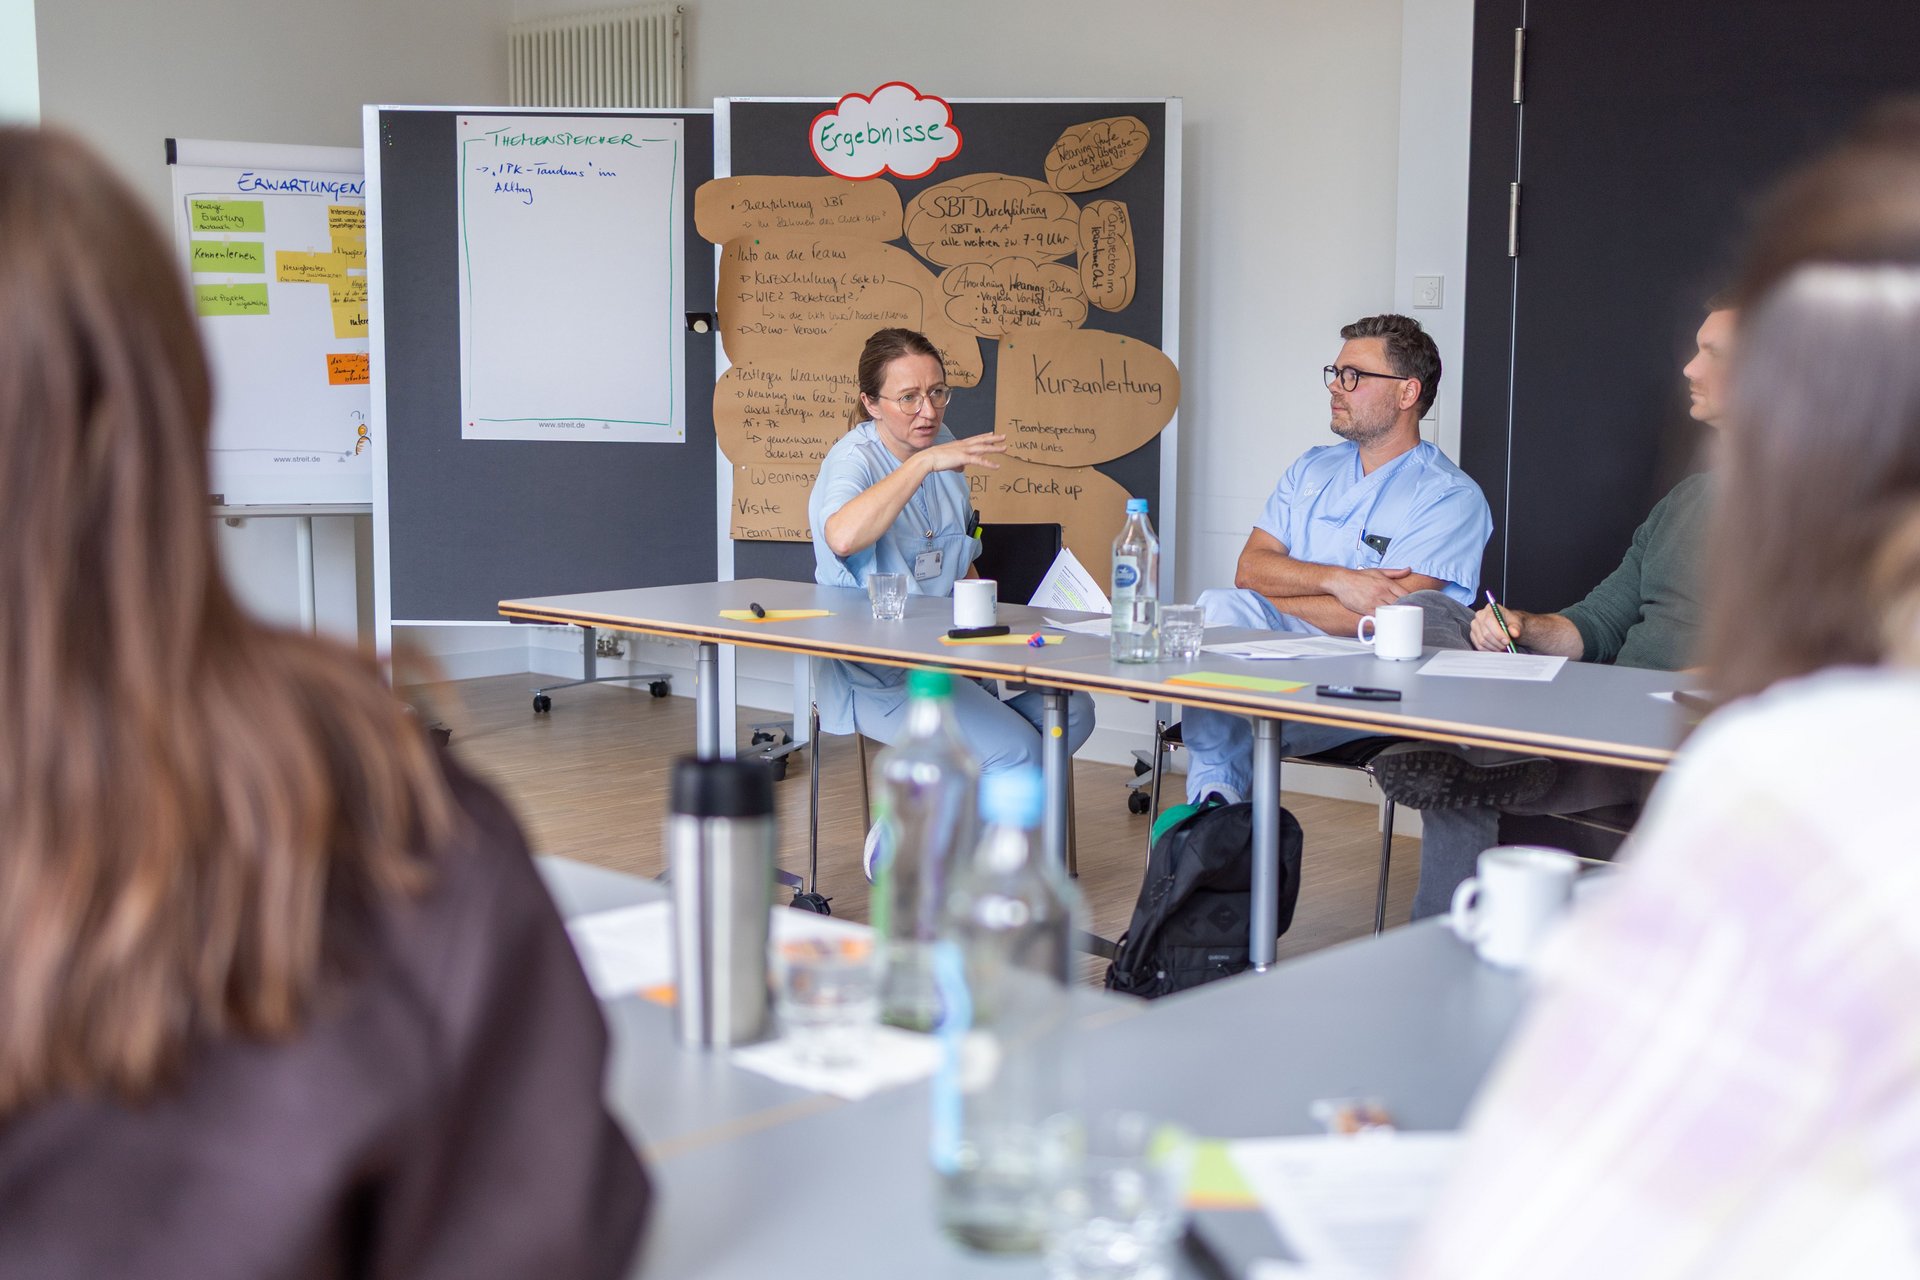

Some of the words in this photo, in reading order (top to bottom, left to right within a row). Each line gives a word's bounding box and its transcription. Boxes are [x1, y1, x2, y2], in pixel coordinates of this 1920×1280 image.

[485, 127, 642, 148] THEMENSPEICHER
[820, 117, 944, 157] Ergebnisse
[237, 172, 366, 202] ERWARTUNGEN
[926, 195, 974, 219] SBT
[950, 223, 973, 234] SBT
[940, 236, 960, 247] alle
[1046, 232, 1070, 246] Uhr
[194, 247, 257, 261] Kennenlernen
[764, 251, 780, 261] an
[786, 249, 806, 262] die
[735, 367, 783, 390] Festlegen
[790, 367, 861, 393] Weaningstuf
[1032, 354, 1162, 404] Kurzanleitung
[538, 421, 586, 429] www.streit.de
[1011, 418, 1097, 443] Teambesprechung
[750, 467, 819, 488] Weanings
[965, 474, 991, 493] BT
[1012, 477, 1061, 496] Check
[1064, 484, 1083, 501] up
[738, 497, 782, 515] Visite
[736, 525, 772, 539] Team
[770, 526, 802, 539] Time
